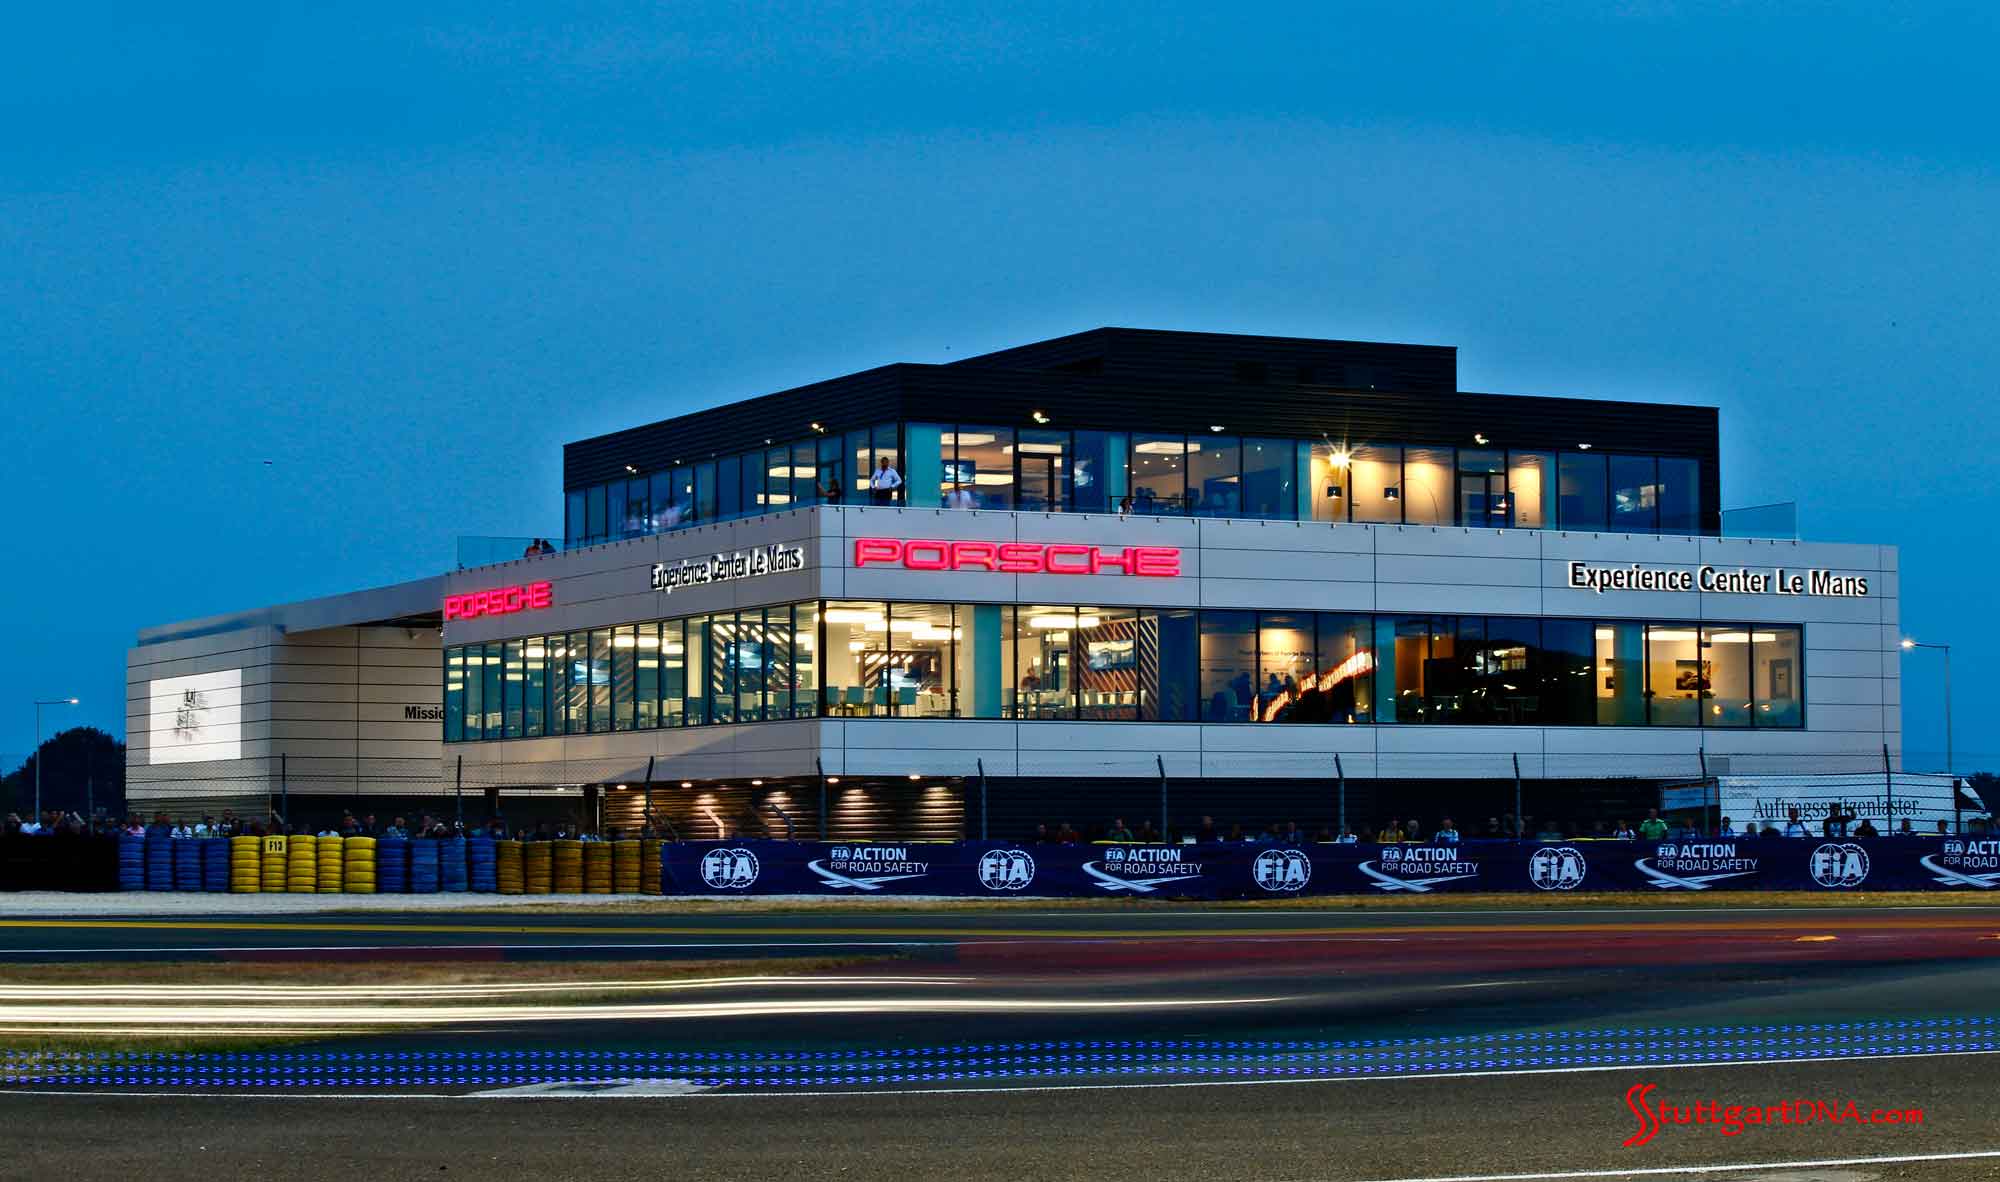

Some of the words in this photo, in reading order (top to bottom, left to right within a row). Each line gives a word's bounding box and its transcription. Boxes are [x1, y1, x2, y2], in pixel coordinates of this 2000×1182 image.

[855, 538, 1180, 577] PORSCHE
[649, 558, 710, 594] Experience
[710, 553, 747, 581] Center
[749, 548, 765, 574] Le
[767, 544, 802, 571] Mans
[1570, 562, 1693, 593] Experience
[1698, 565, 1771, 593] Center
[1777, 568, 1803, 594] Le
[1810, 570, 1868, 596] Mans
[445, 581, 552, 621] PORSCHE
[853, 847, 907, 860] ACTION
[1128, 848, 1181, 862] ACTION
[1404, 847, 1457, 861] ACTION
[1680, 843, 1736, 858] ACTION
[831, 861, 847, 870] FOR
[848, 861, 882, 873] ROAD
[884, 861, 929, 873] SAFETY
[1105, 863, 1122, 871] FOR
[1124, 863, 1156, 874] ROAD
[1158, 863, 1202, 874] SAFETY
[1381, 862, 1398, 872] FOR
[1400, 862, 1432, 874] ROAD
[1434, 862, 1479, 873] SAFETY
[1657, 859, 1674, 868] FOR
[1676, 859, 1710, 871] ROAD
[1712, 858, 1758, 870] SAFETY
[1943, 856, 1961, 865] FOR
[1963, 856, 1998, 869] ROAD
